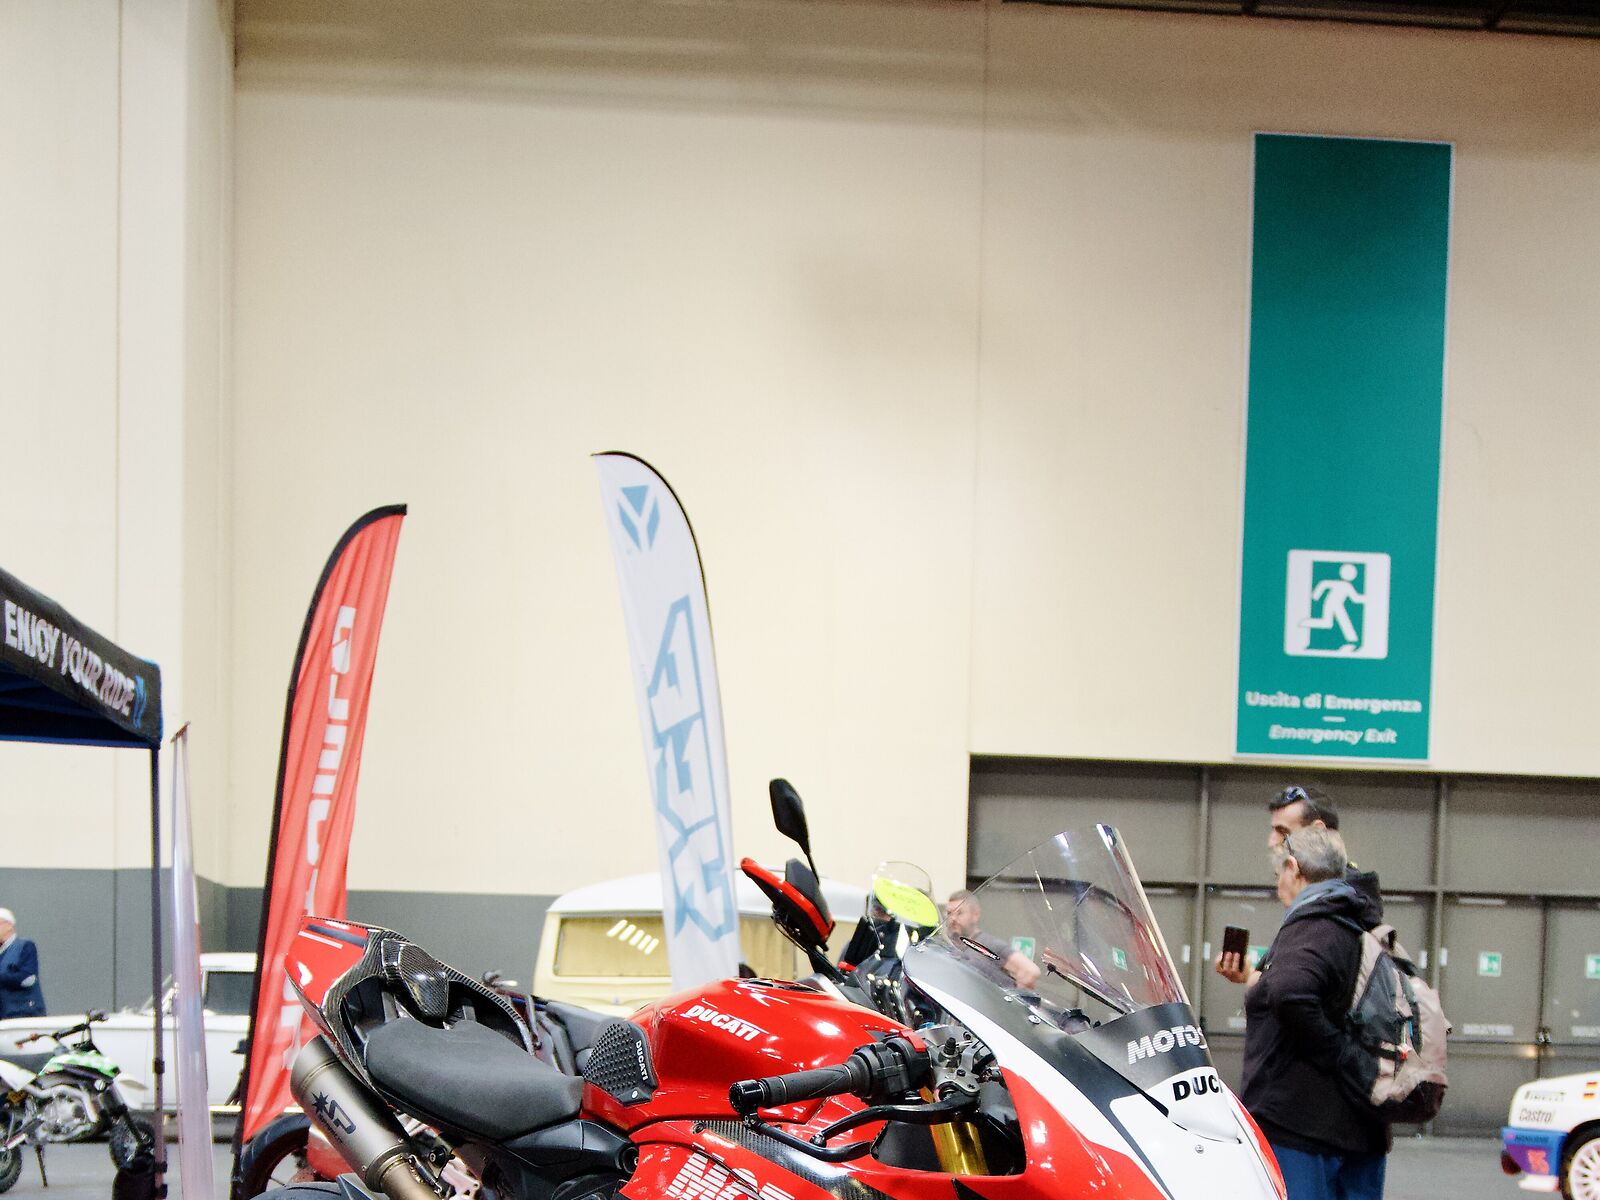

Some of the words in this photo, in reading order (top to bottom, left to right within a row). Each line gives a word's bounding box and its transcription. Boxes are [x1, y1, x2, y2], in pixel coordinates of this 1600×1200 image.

[5, 600, 60, 668] ENJOY
[61, 632, 102, 696] YOUR
[100, 662, 135, 716] RIDE
[1246, 691, 1300, 708] Uscita
[1303, 692, 1322, 709] di
[1325, 694, 1422, 714] Emergenza
[1268, 724, 1363, 745] Emergency
[1364, 728, 1398, 744] Exit
[684, 1005, 760, 1041] DUCATI
[635, 1040, 649, 1080] DUCATI
[1173, 1074, 1222, 1101] DUC
